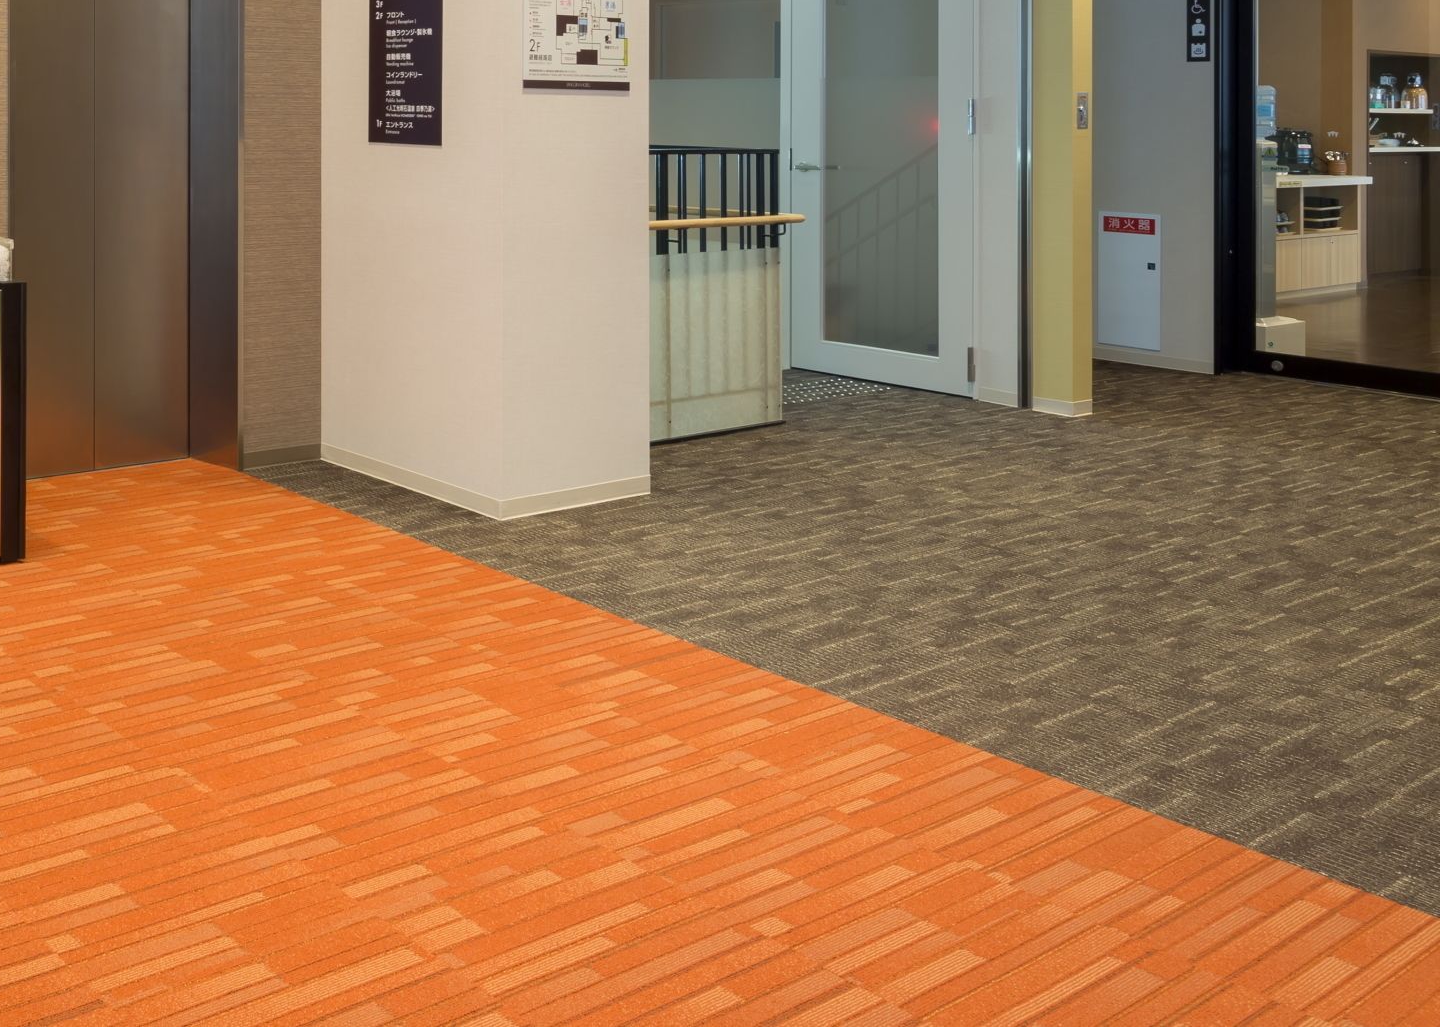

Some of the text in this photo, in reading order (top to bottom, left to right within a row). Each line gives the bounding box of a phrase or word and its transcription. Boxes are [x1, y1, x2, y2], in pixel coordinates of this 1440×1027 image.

[375, 11, 384, 20] 2F
[386, 11, 405, 19] フロント
[529, 38, 541, 53] 2F
[1108, 217, 1151, 231] 消火器
